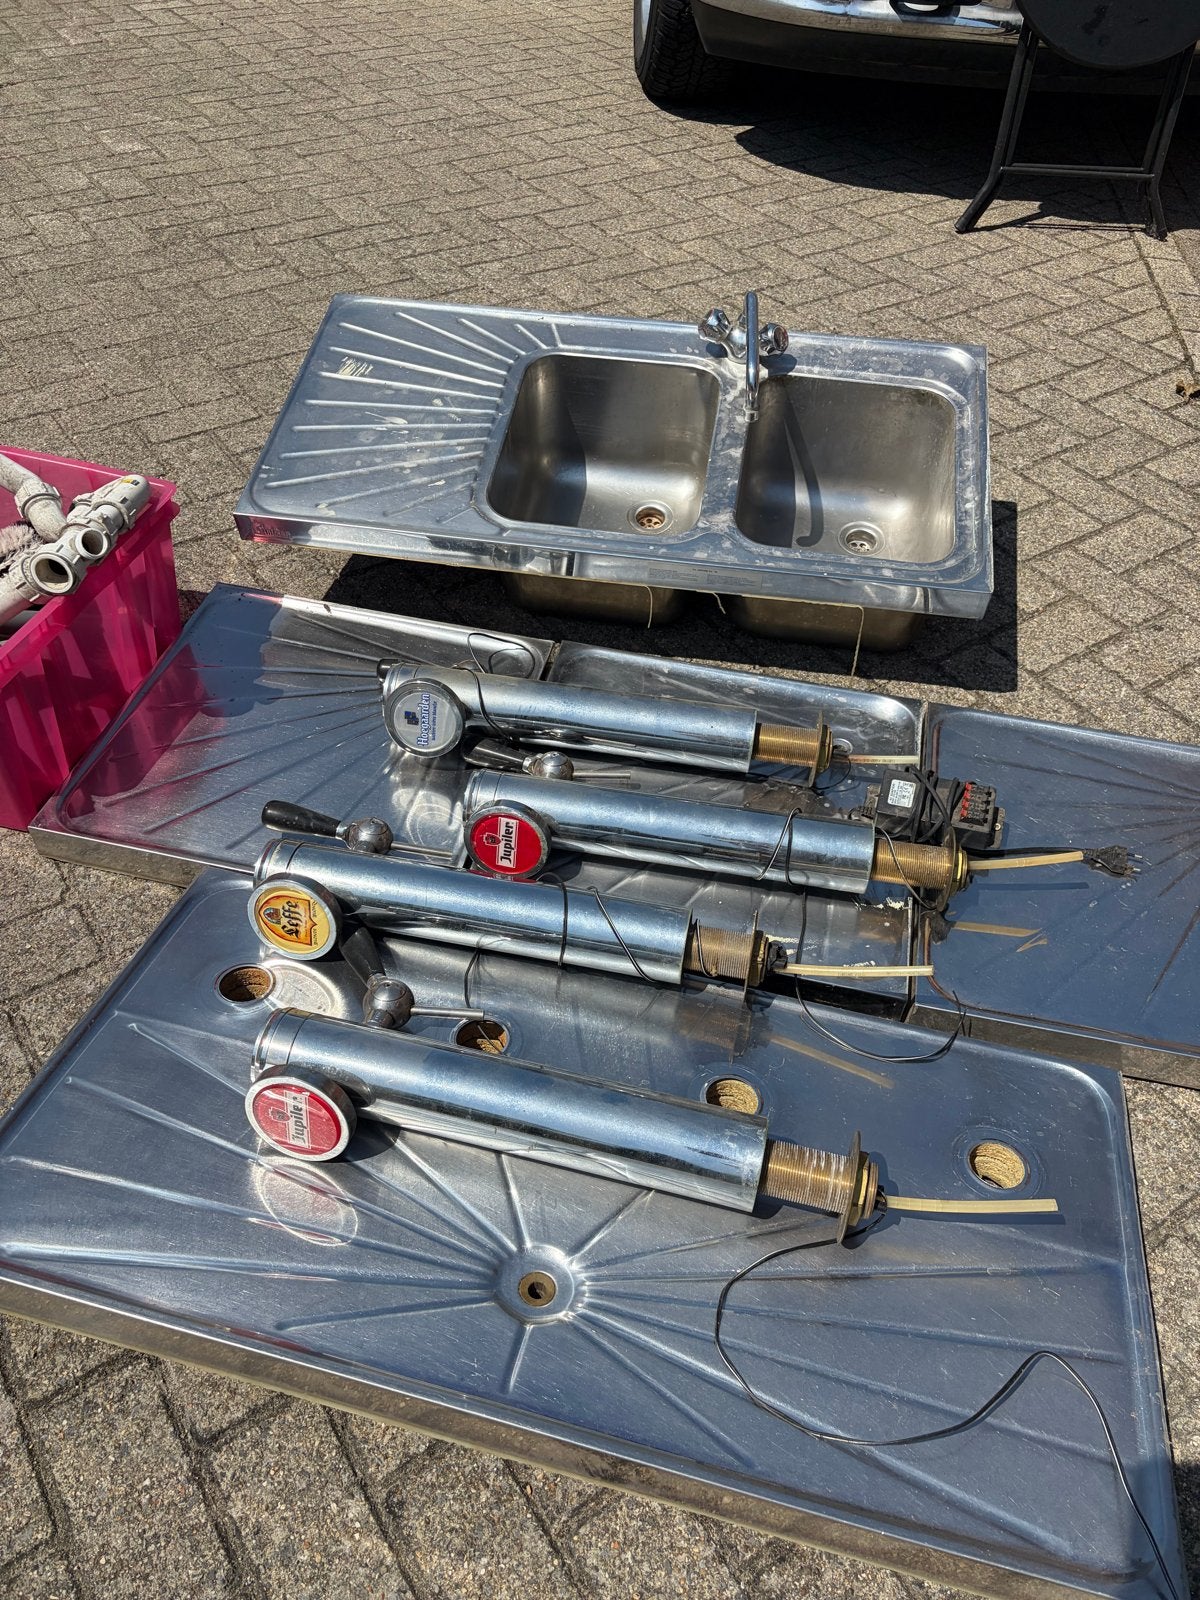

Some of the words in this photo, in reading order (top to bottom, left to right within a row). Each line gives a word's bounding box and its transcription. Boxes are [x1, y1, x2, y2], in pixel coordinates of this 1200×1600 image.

[416, 691, 431, 746] Hoegaarden
[500, 821, 515, 865] Jupiler
[281, 900, 303, 939] Leffe
[290, 1096, 308, 1144] Jupiler
